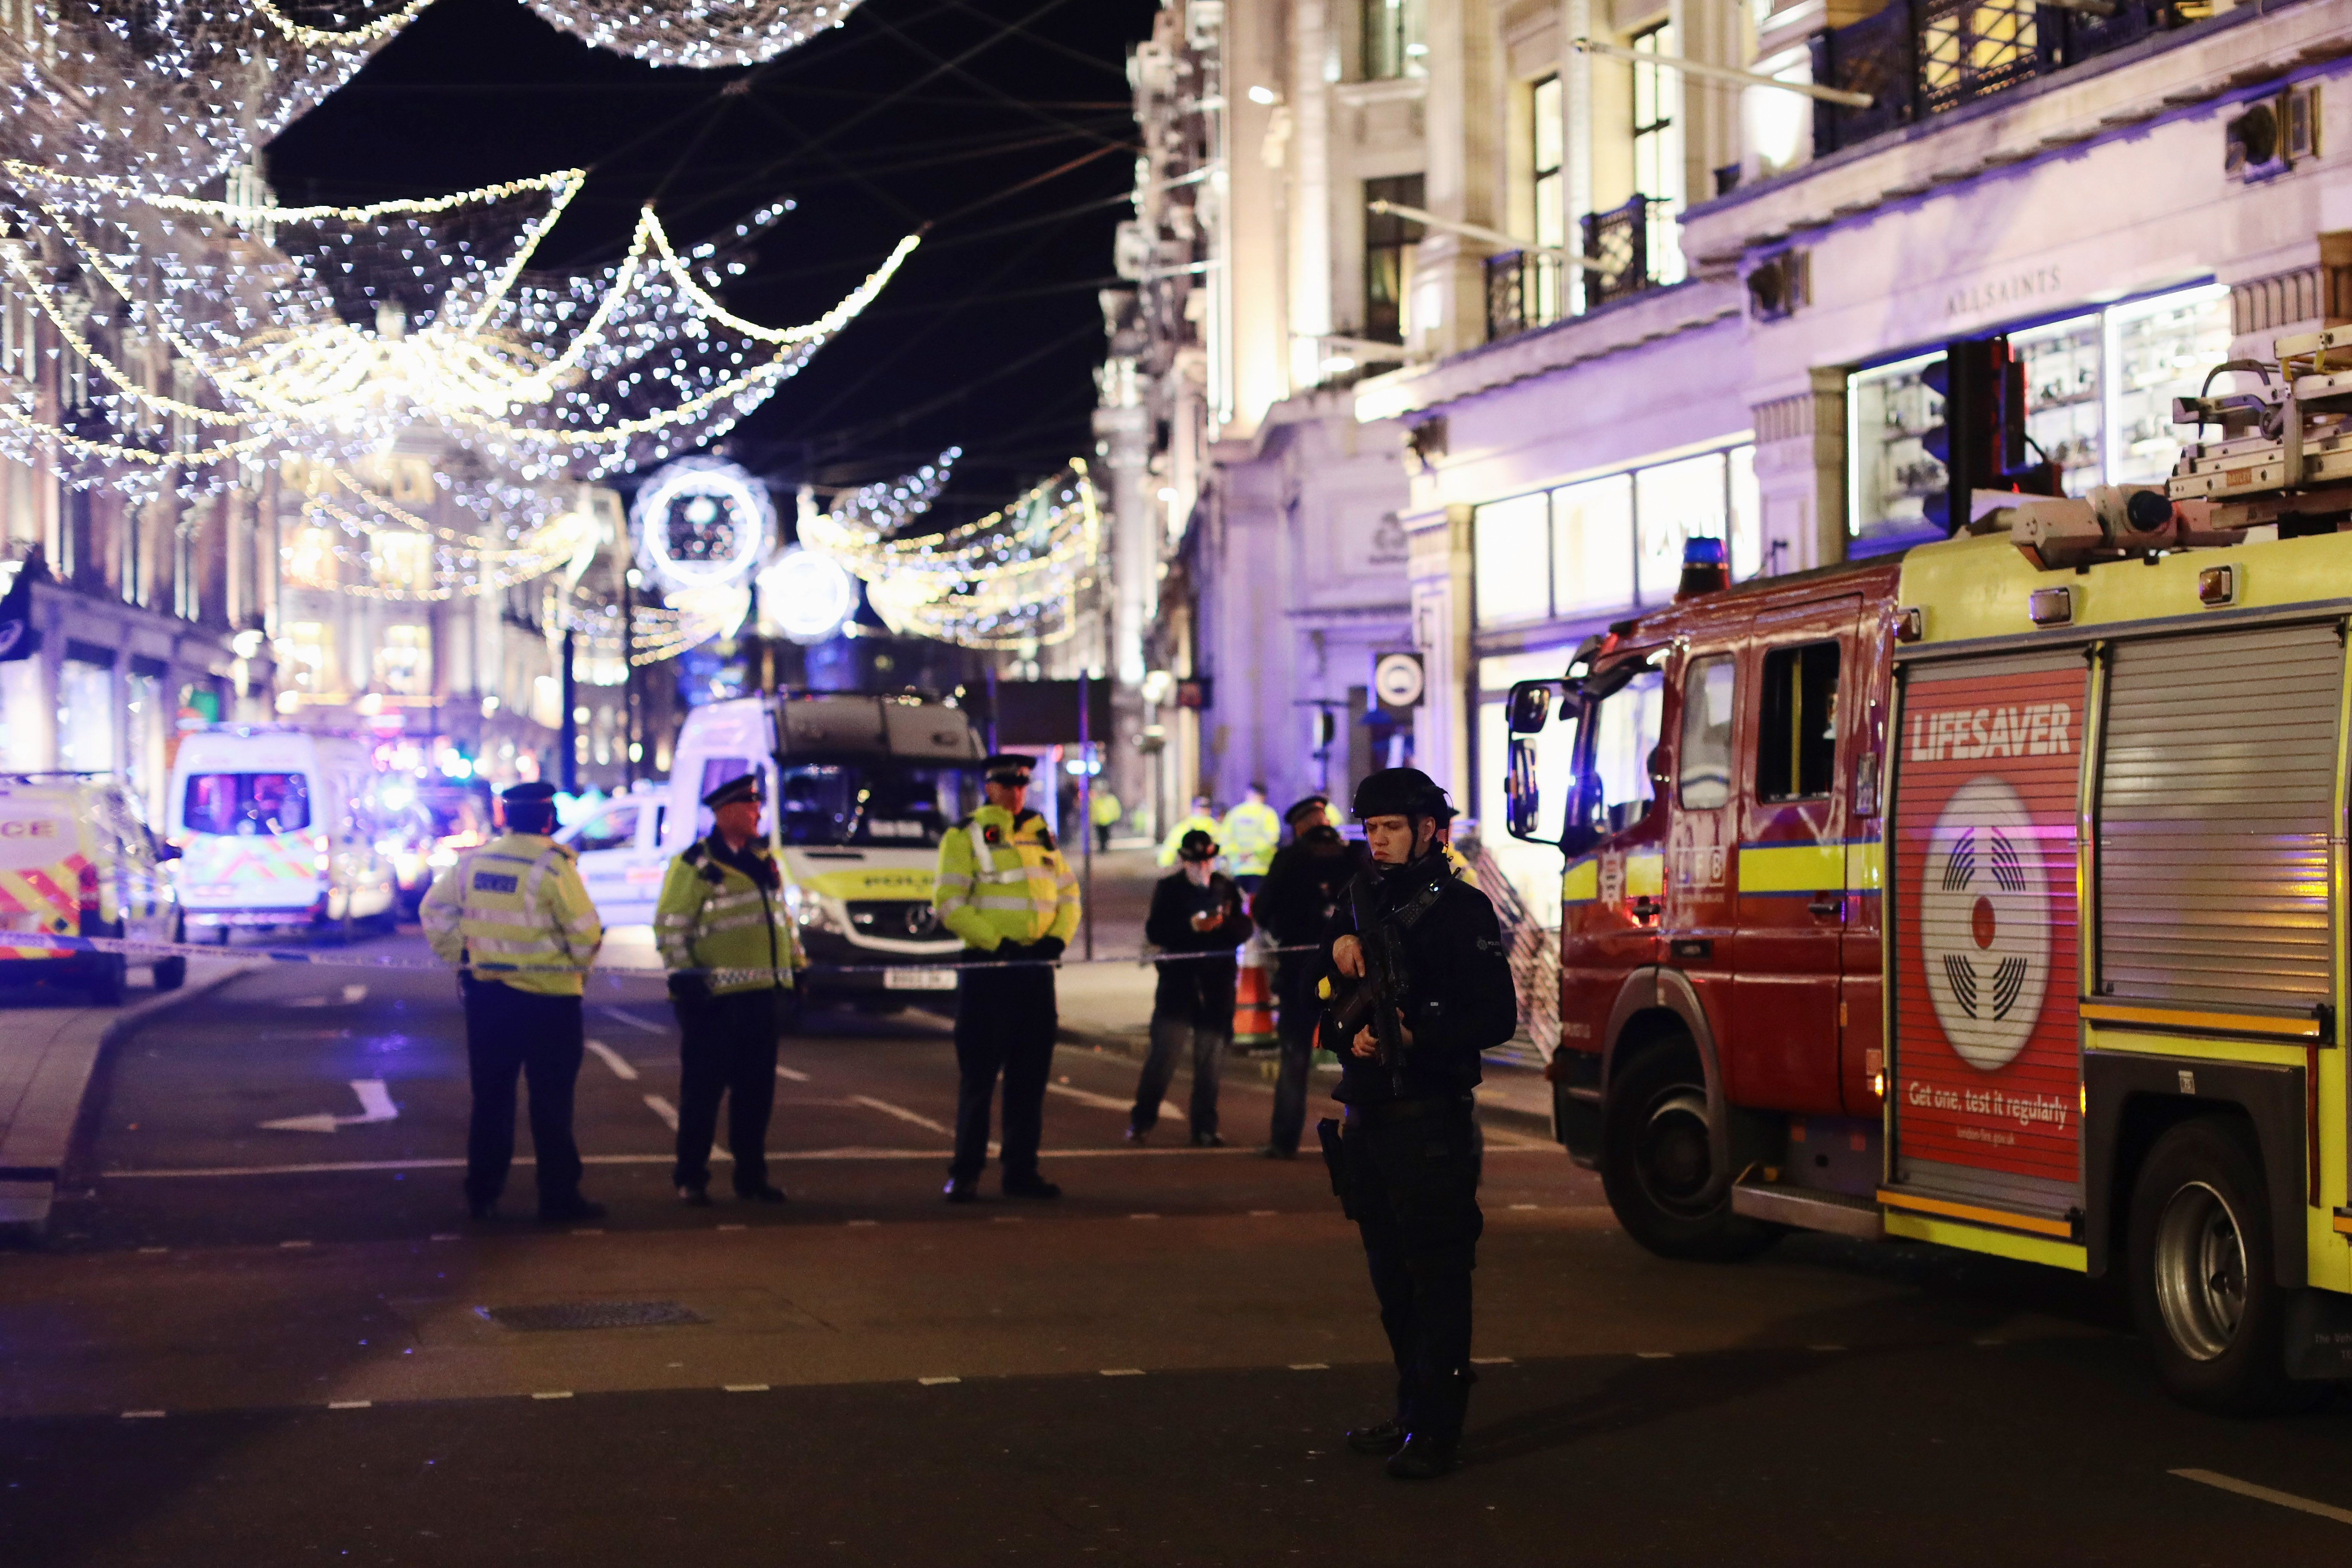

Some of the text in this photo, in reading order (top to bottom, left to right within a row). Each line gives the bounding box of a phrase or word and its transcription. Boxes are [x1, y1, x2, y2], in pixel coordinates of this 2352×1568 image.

[1944, 264, 2061, 317] ALLSAINTS
[1911, 703, 2071, 762] LIFESAVER
[1909, 1081, 2067, 1130] Get one, test it regularly
